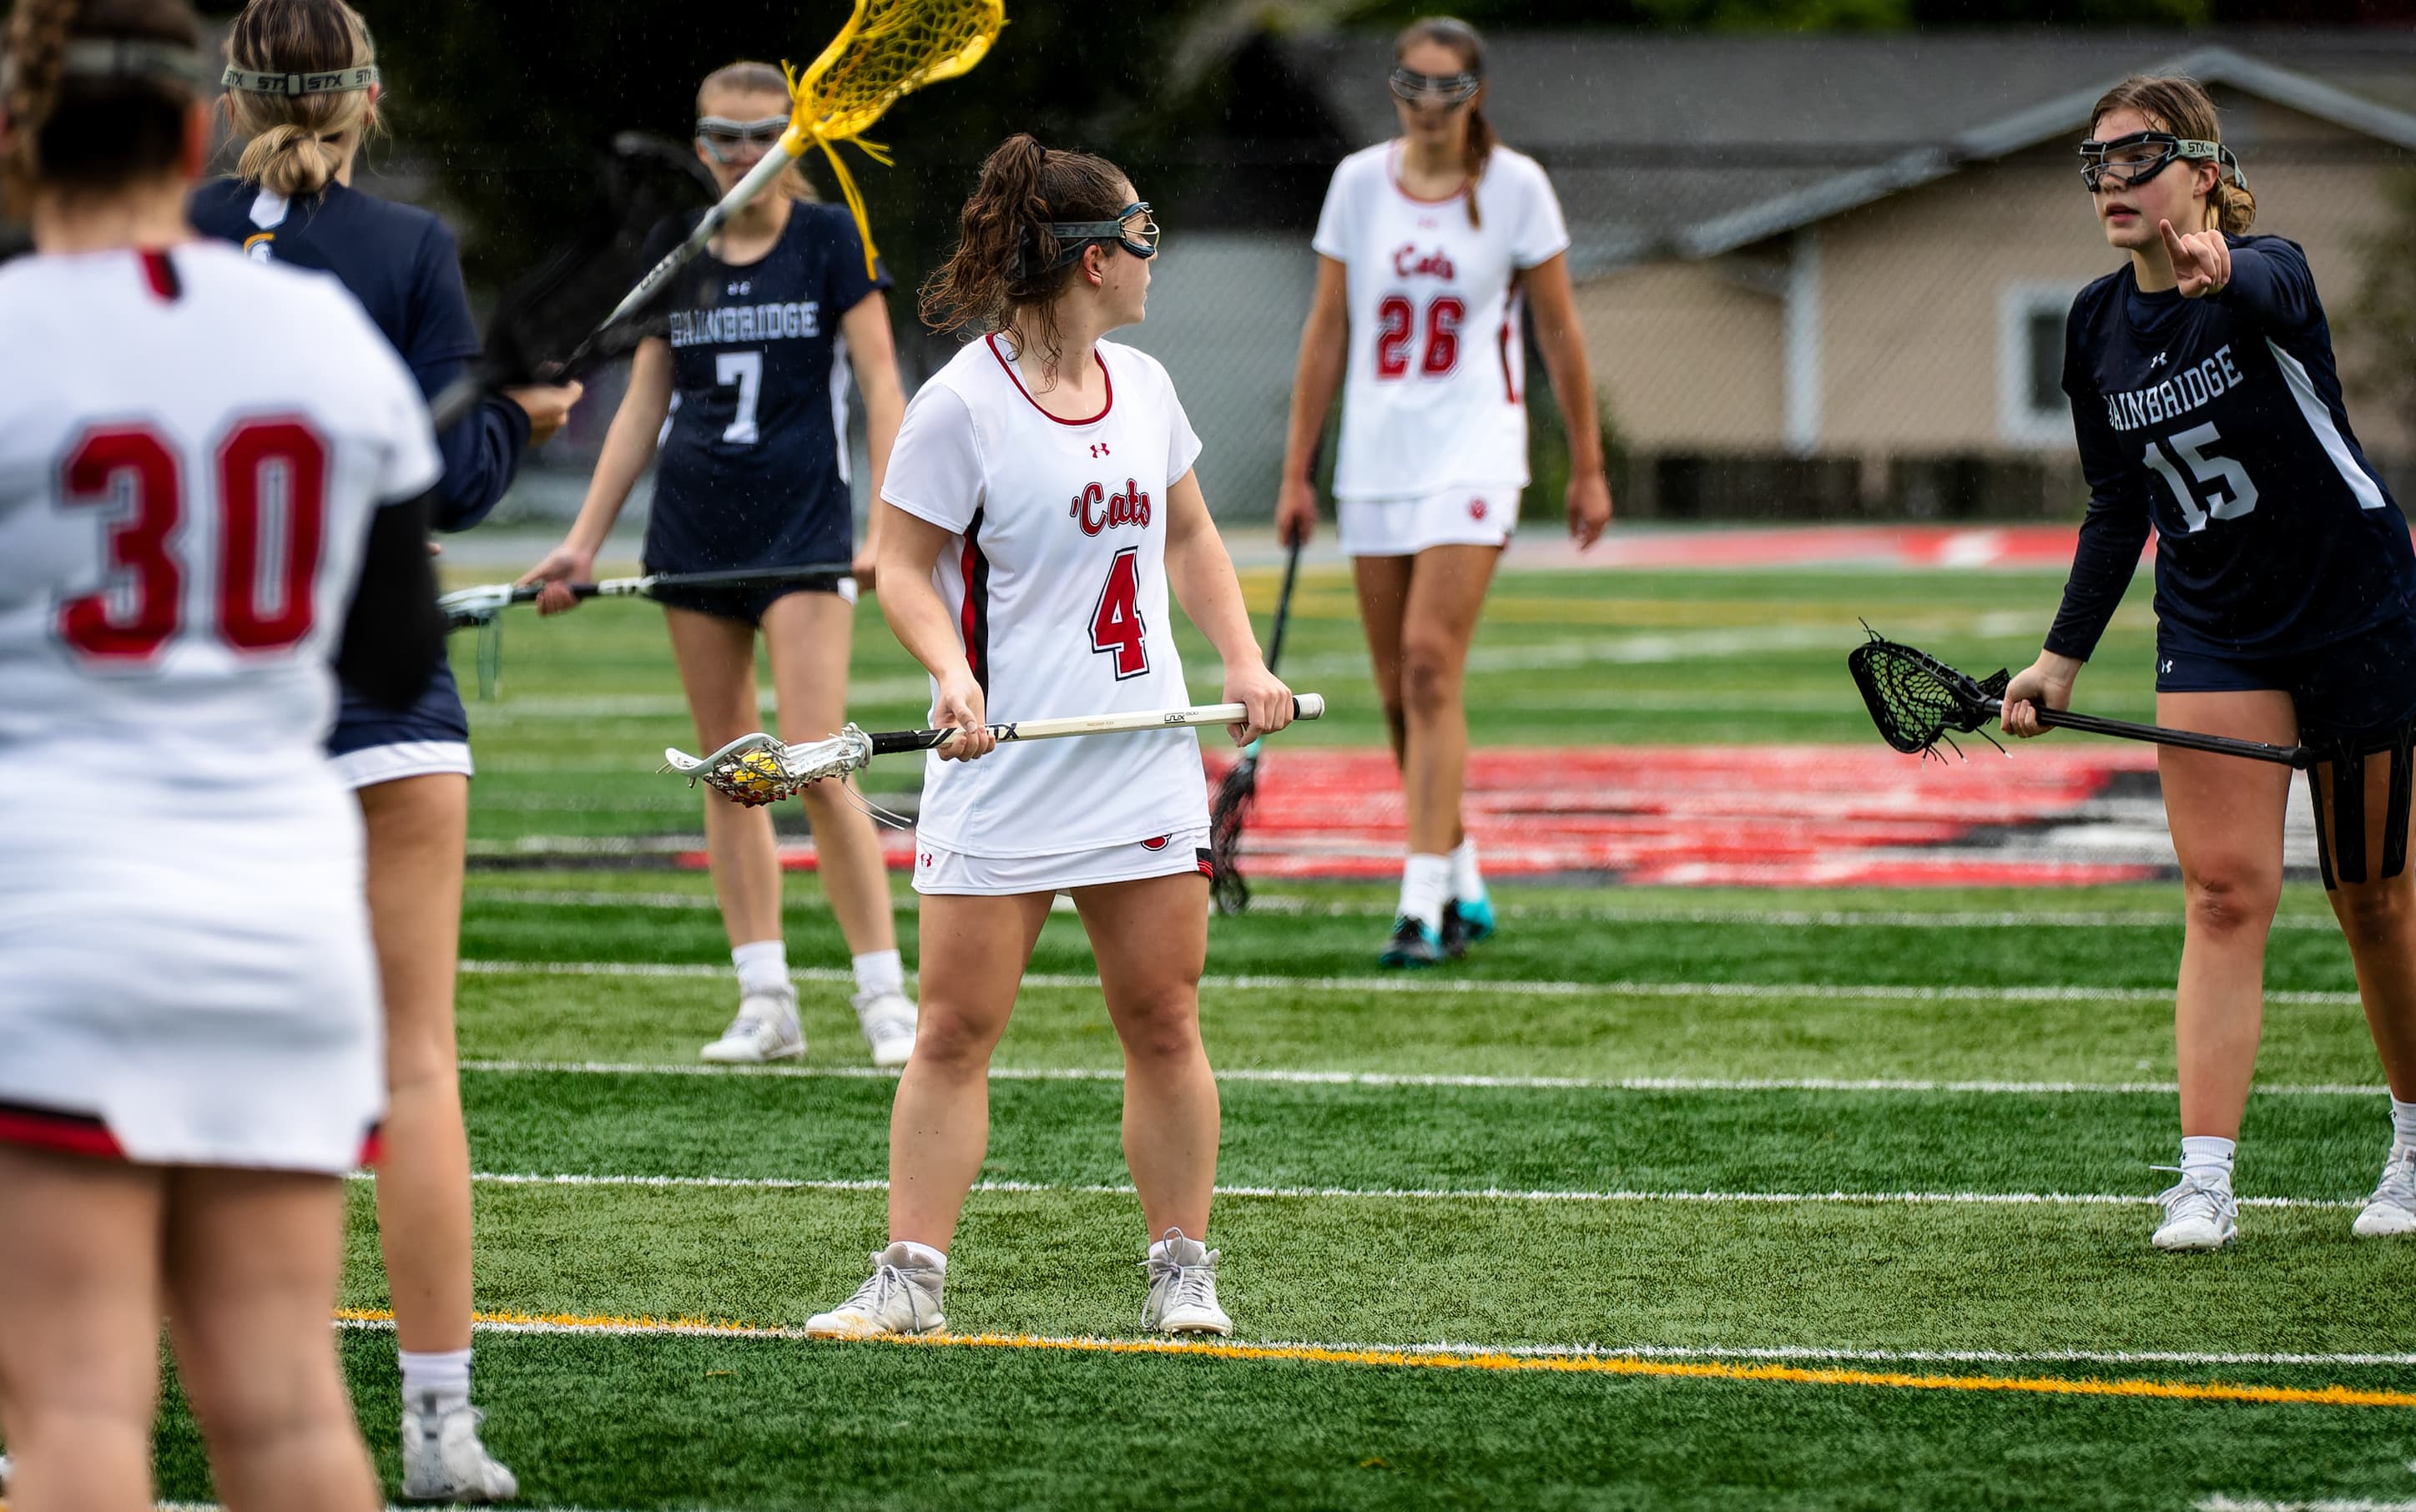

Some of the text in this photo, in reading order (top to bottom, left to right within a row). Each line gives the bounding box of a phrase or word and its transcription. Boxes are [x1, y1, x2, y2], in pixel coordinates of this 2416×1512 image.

[307, 73, 342, 90] STX
[2187, 142, 2206, 154] STX
[1375, 295, 1465, 377] 26
[715, 350, 763, 444] 7
[2142, 421, 2259, 533] 15
[56, 416, 329, 668] 30
[1087, 545, 1150, 682] 4
[986, 723, 1019, 740] TX
